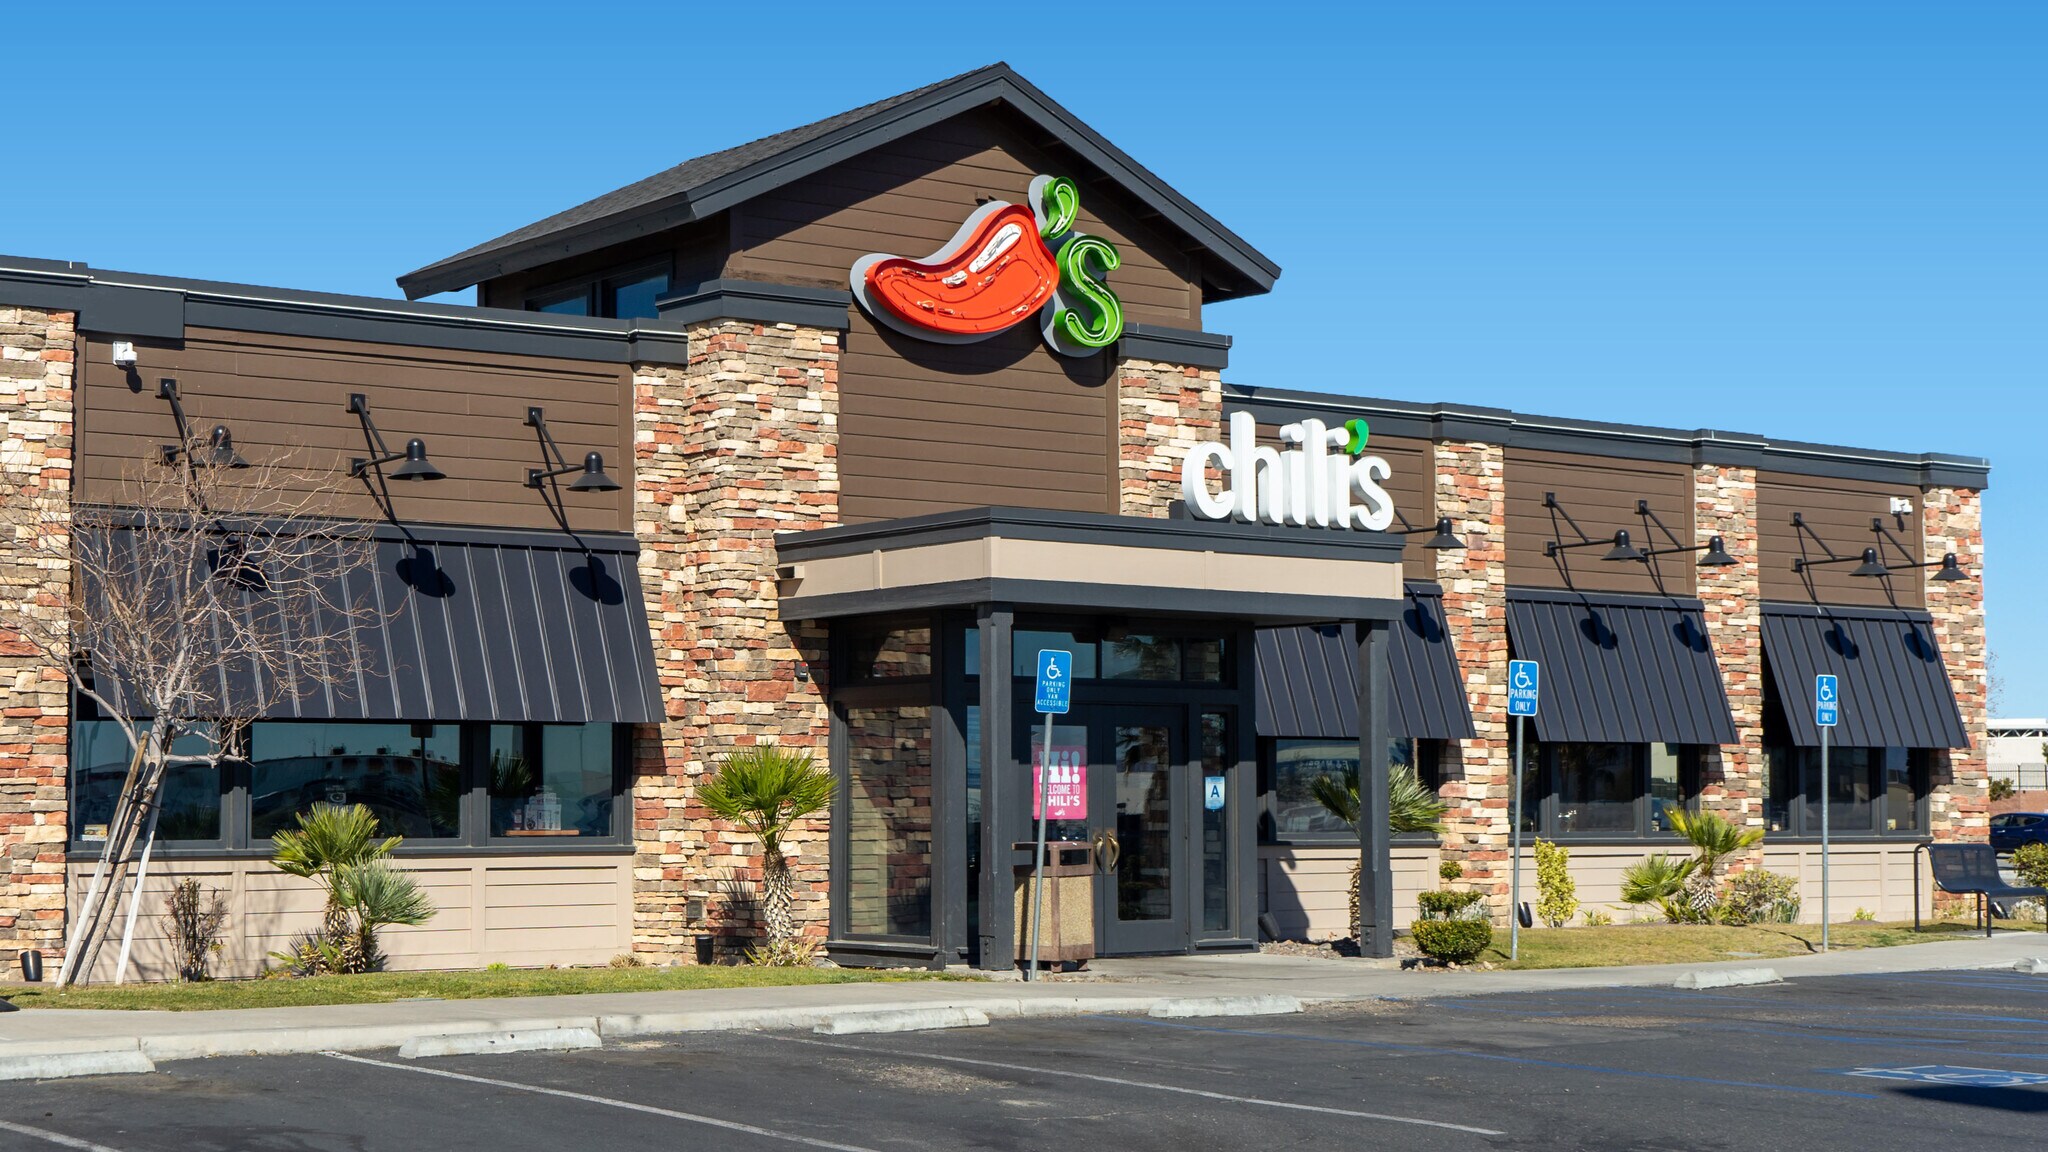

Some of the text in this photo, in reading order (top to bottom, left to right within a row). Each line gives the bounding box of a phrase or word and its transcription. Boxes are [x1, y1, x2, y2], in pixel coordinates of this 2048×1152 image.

[1181, 411, 1395, 532] chili's
[1042, 680, 1066, 688] PARKING
[1510, 688, 1537, 700] PARKING
[1037, 699, 1068, 707] ACCESSIBLE
[1515, 700, 1531, 712] ONLY
[1072, 784, 1081, 795] TO
[1210, 784, 1220, 798] A
[1039, 794, 1081, 807] HILI'S
